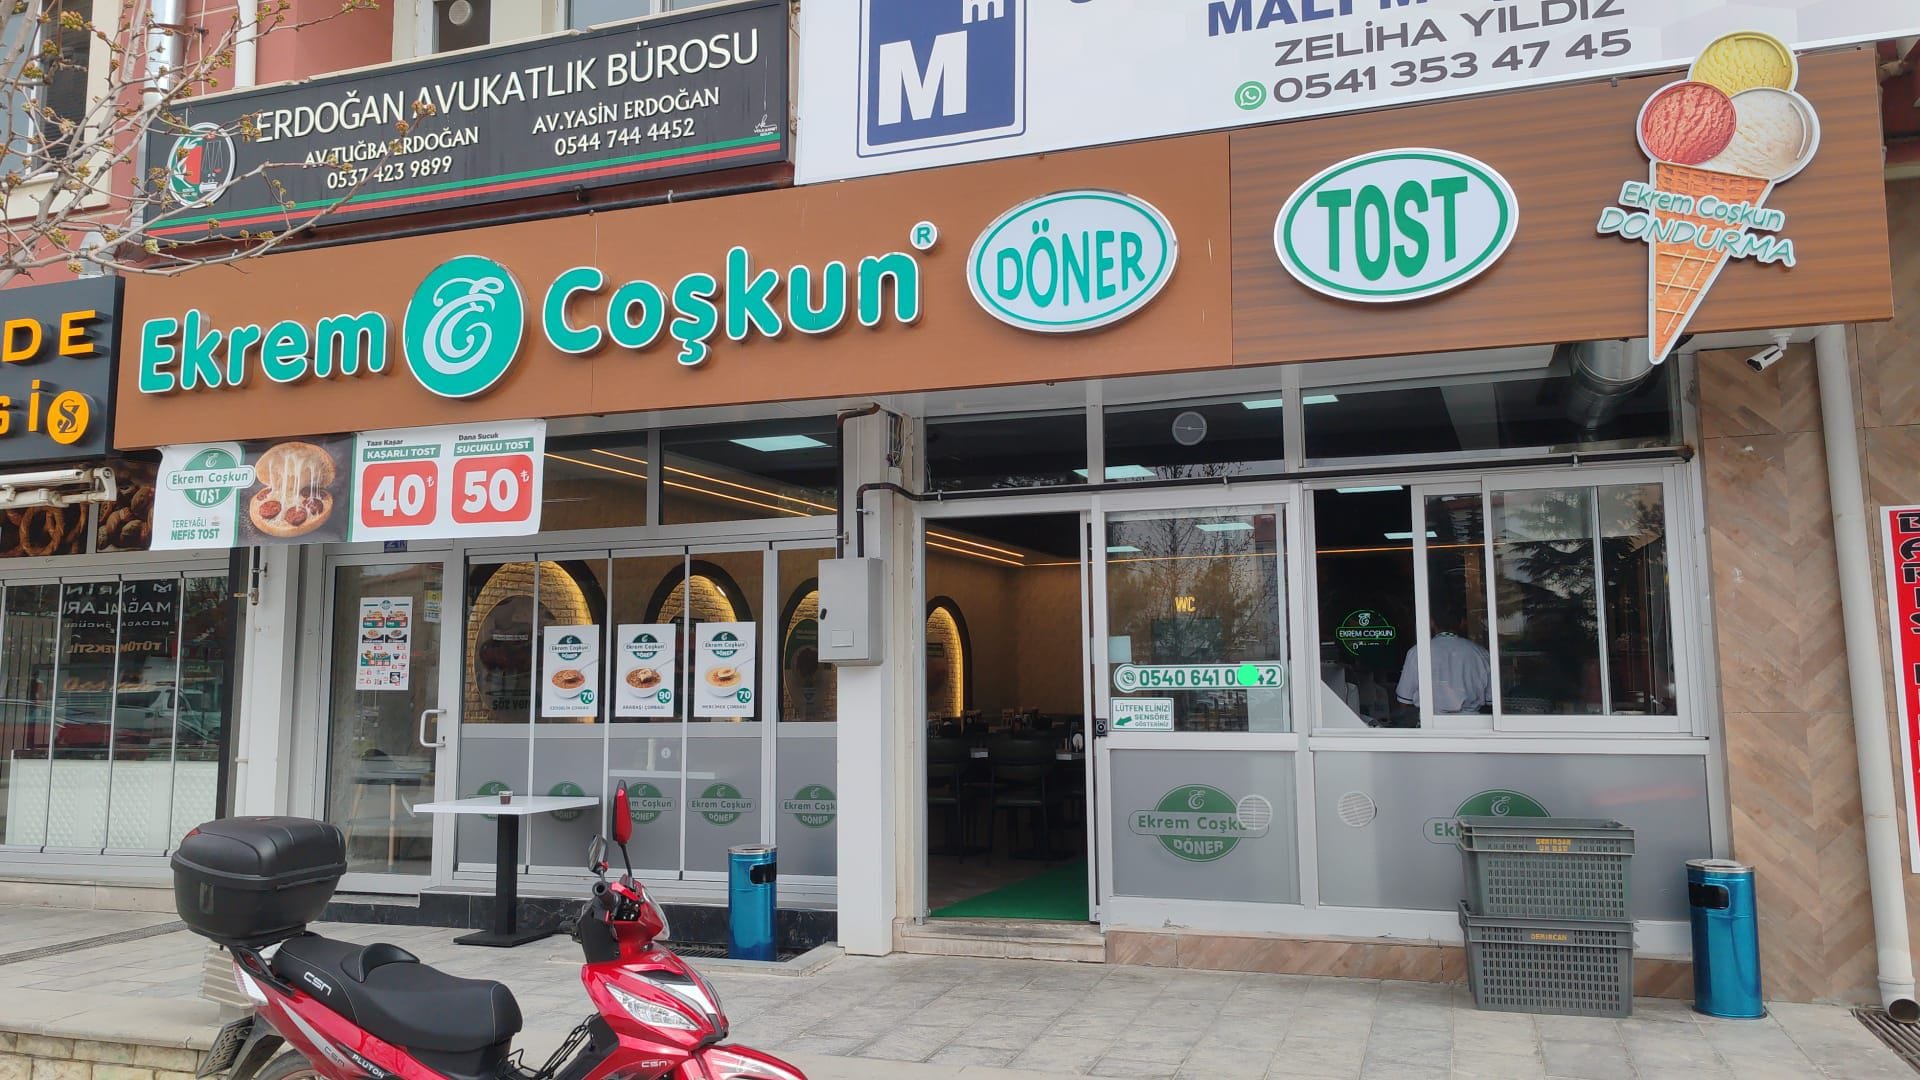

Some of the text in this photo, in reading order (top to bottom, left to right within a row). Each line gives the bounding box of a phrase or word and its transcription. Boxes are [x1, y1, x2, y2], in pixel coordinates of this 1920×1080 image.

[1275, 0, 1625, 67] ZELİHA YILDIZ
[1273, 28, 1632, 103] 0541 353 47 45
[255, 28, 758, 143] ERDOĞAN AVUKATLIK BÜROSU
[878, 30, 968, 126] M
[532, 86, 720, 135] AV.YASİN ERDOĞAN
[555, 118, 695, 156] 0544 744 4452
[302, 140, 388, 169] AVTUĞBA
[327, 155, 453, 189] 0537 423 9899
[1622, 183, 1782, 229] Ekrem Coşkun
[1317, 176, 1468, 281] TOST
[1600, 209, 1793, 264] DONDURMA
[997, 218, 1146, 308] DÖNER
[138, 309, 390, 394] Ekrem
[542, 245, 921, 367] Coşkun
[367, 447, 436, 460] KAŞARLI TOST
[456, 440, 531, 454] SUCUKLU TOST
[172, 471, 248, 485] Ekrem Coşkun
[195, 489, 220, 504] TOST
[172, 517, 207, 528] TEREYAĞLI
[197, 528, 220, 540] TOST
[1175, 597, 1196, 612] WC
[1139, 669, 1186, 686] 0540
[1190, 669, 1219, 686] 641
[1225, 668, 1246, 685] 0
[582, 691, 593, 700] 70
[658, 691, 671, 700] 90
[739, 690, 751, 699] 70
[1115, 703, 1143, 711] LÜTFEN
[720, 801, 752, 810] Coşkun
[784, 801, 836, 811] Ekrem Coşk
[1138, 815, 1247, 834] Ekrem Coşk
[1173, 838, 1224, 855] DÖNER
[351, 1053, 385, 1078] PLUTON
